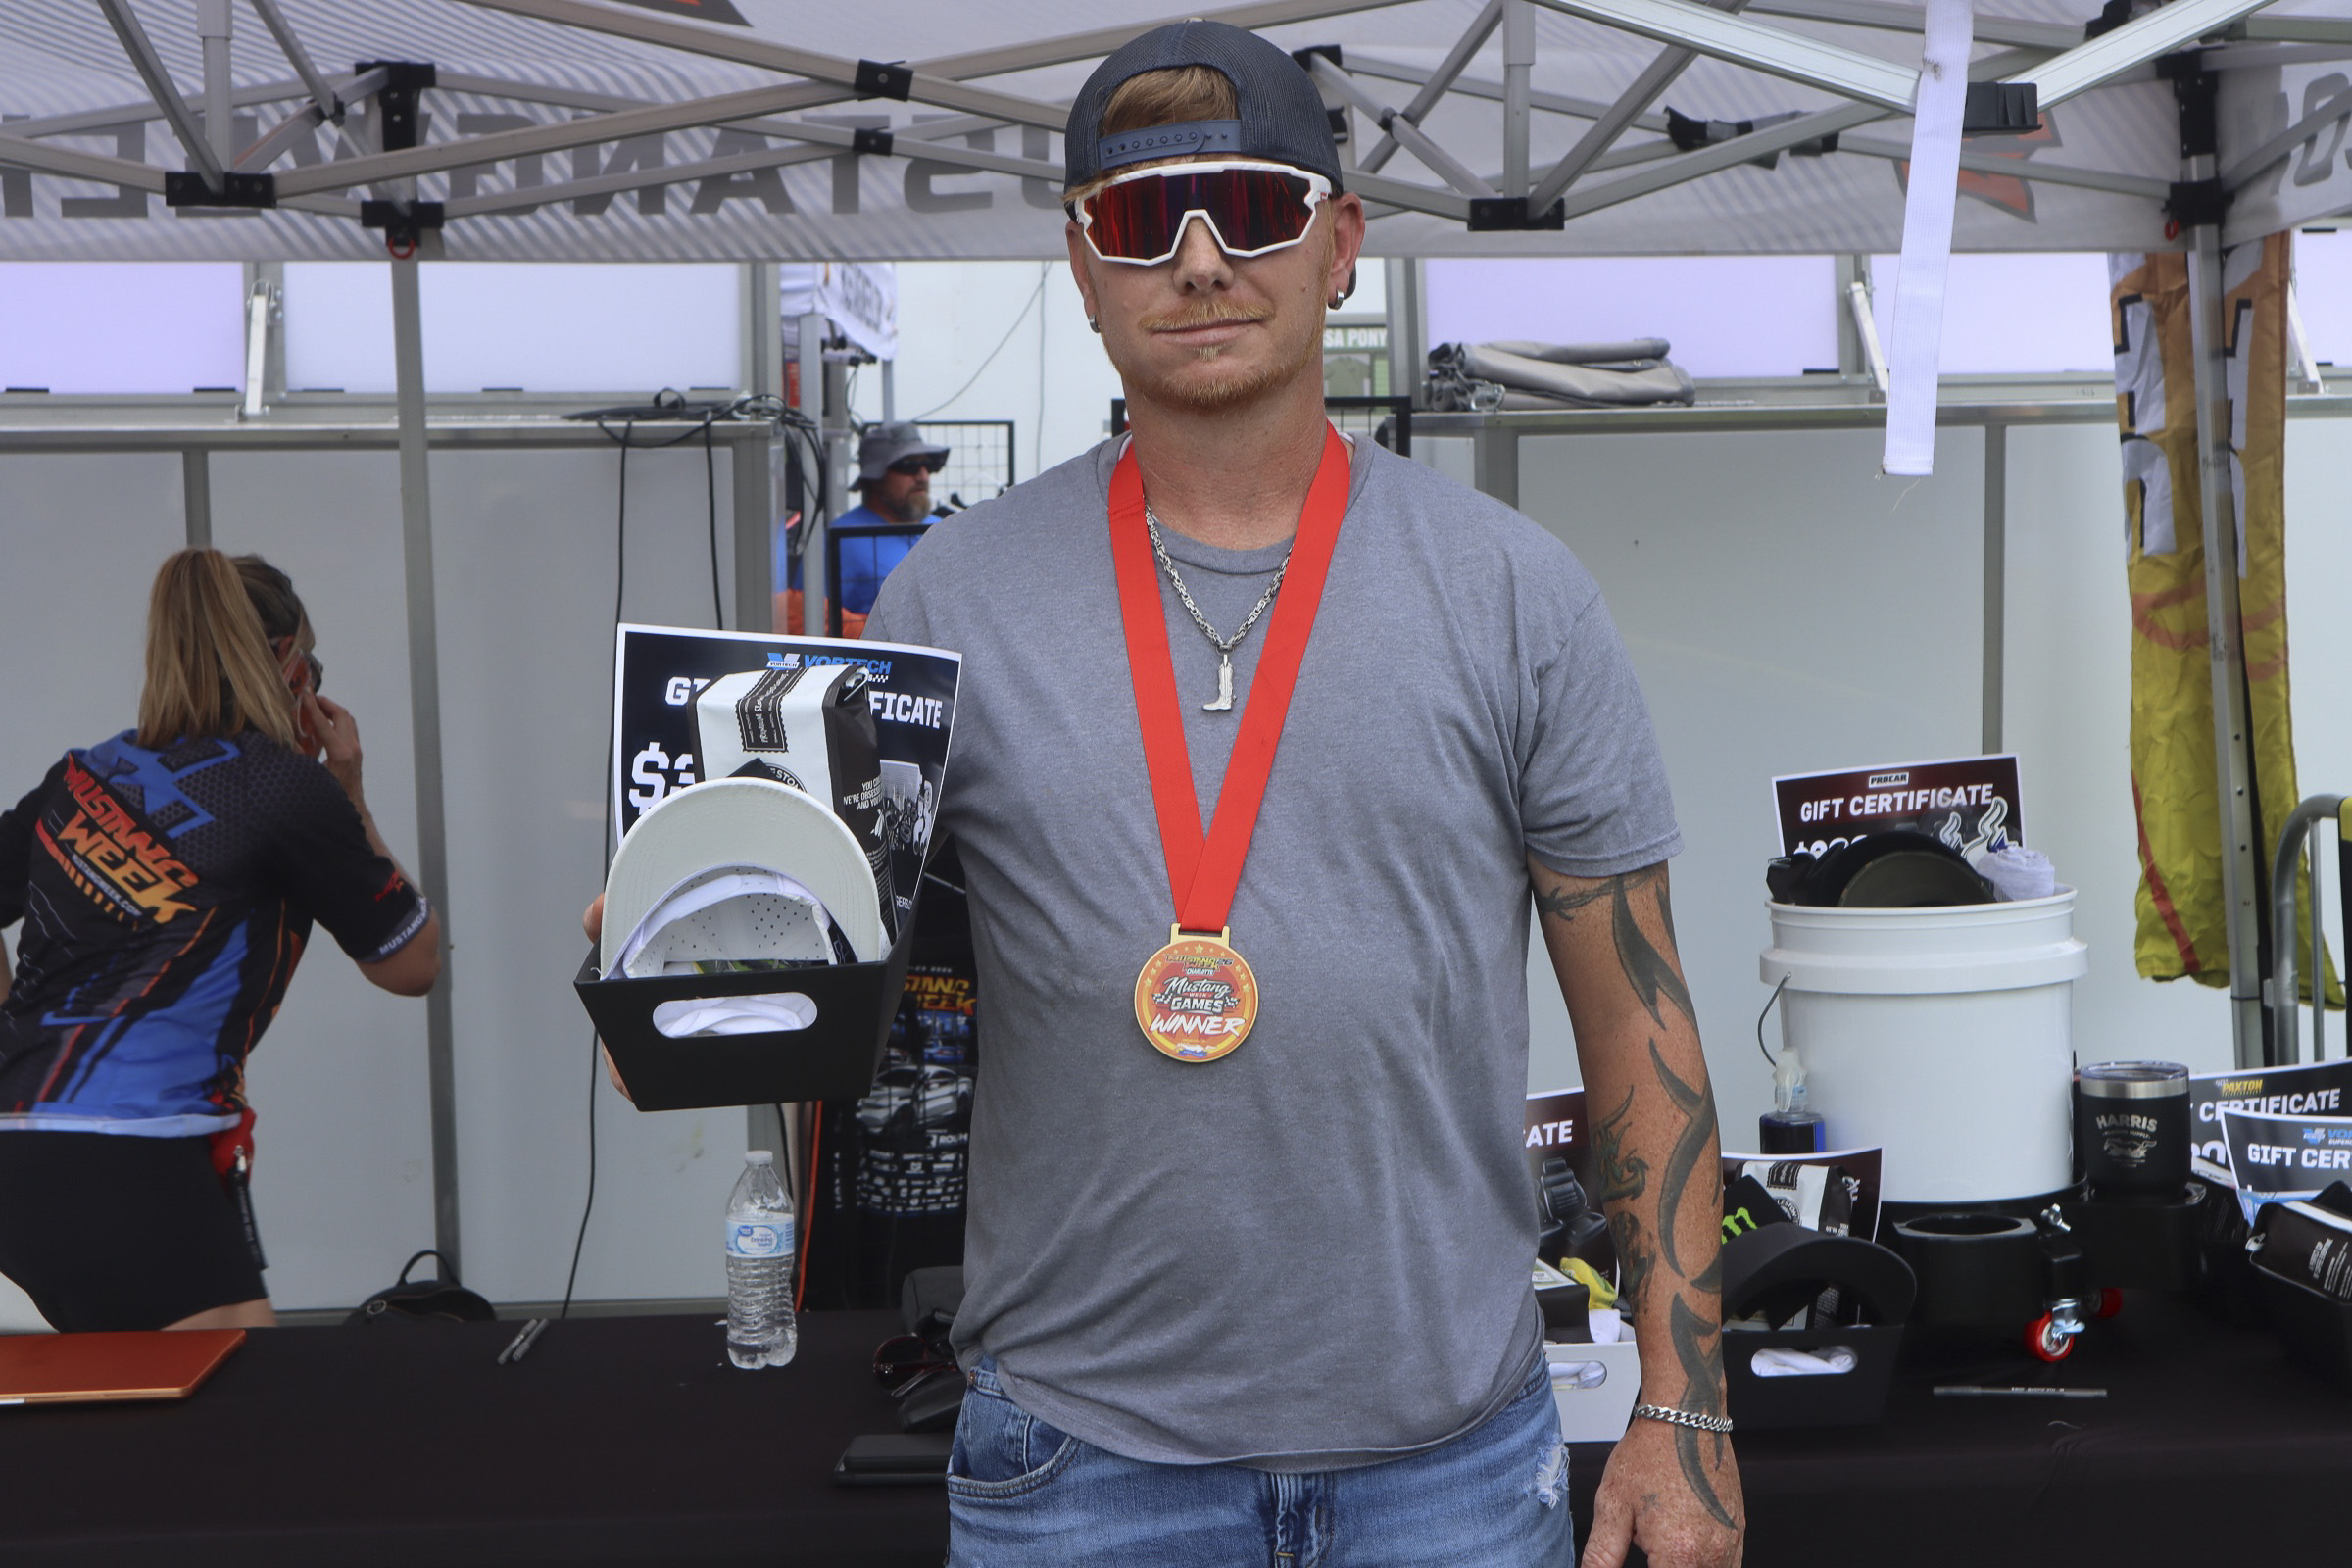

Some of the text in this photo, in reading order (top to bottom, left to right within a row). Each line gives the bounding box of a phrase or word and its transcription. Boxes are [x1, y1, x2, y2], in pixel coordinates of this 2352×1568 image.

[1870, 772, 1907, 785] PROCAR
[1800, 783, 1994, 822] GIFT CERTIFICATE
[63, 752, 199, 889] MUSTANG
[57, 808, 197, 924] WEEK
[1163, 976, 1232, 998] Mustang
[1170, 997, 1224, 1013] GAMES
[1149, 1013, 1246, 1037] WINNER
[2222, 1078, 2264, 1093] PAXTON
[2095, 1114, 2158, 1133] HARRIS
[2247, 1143, 2297, 1167] GIFT
[2301, 1148, 2352, 1170] CER
